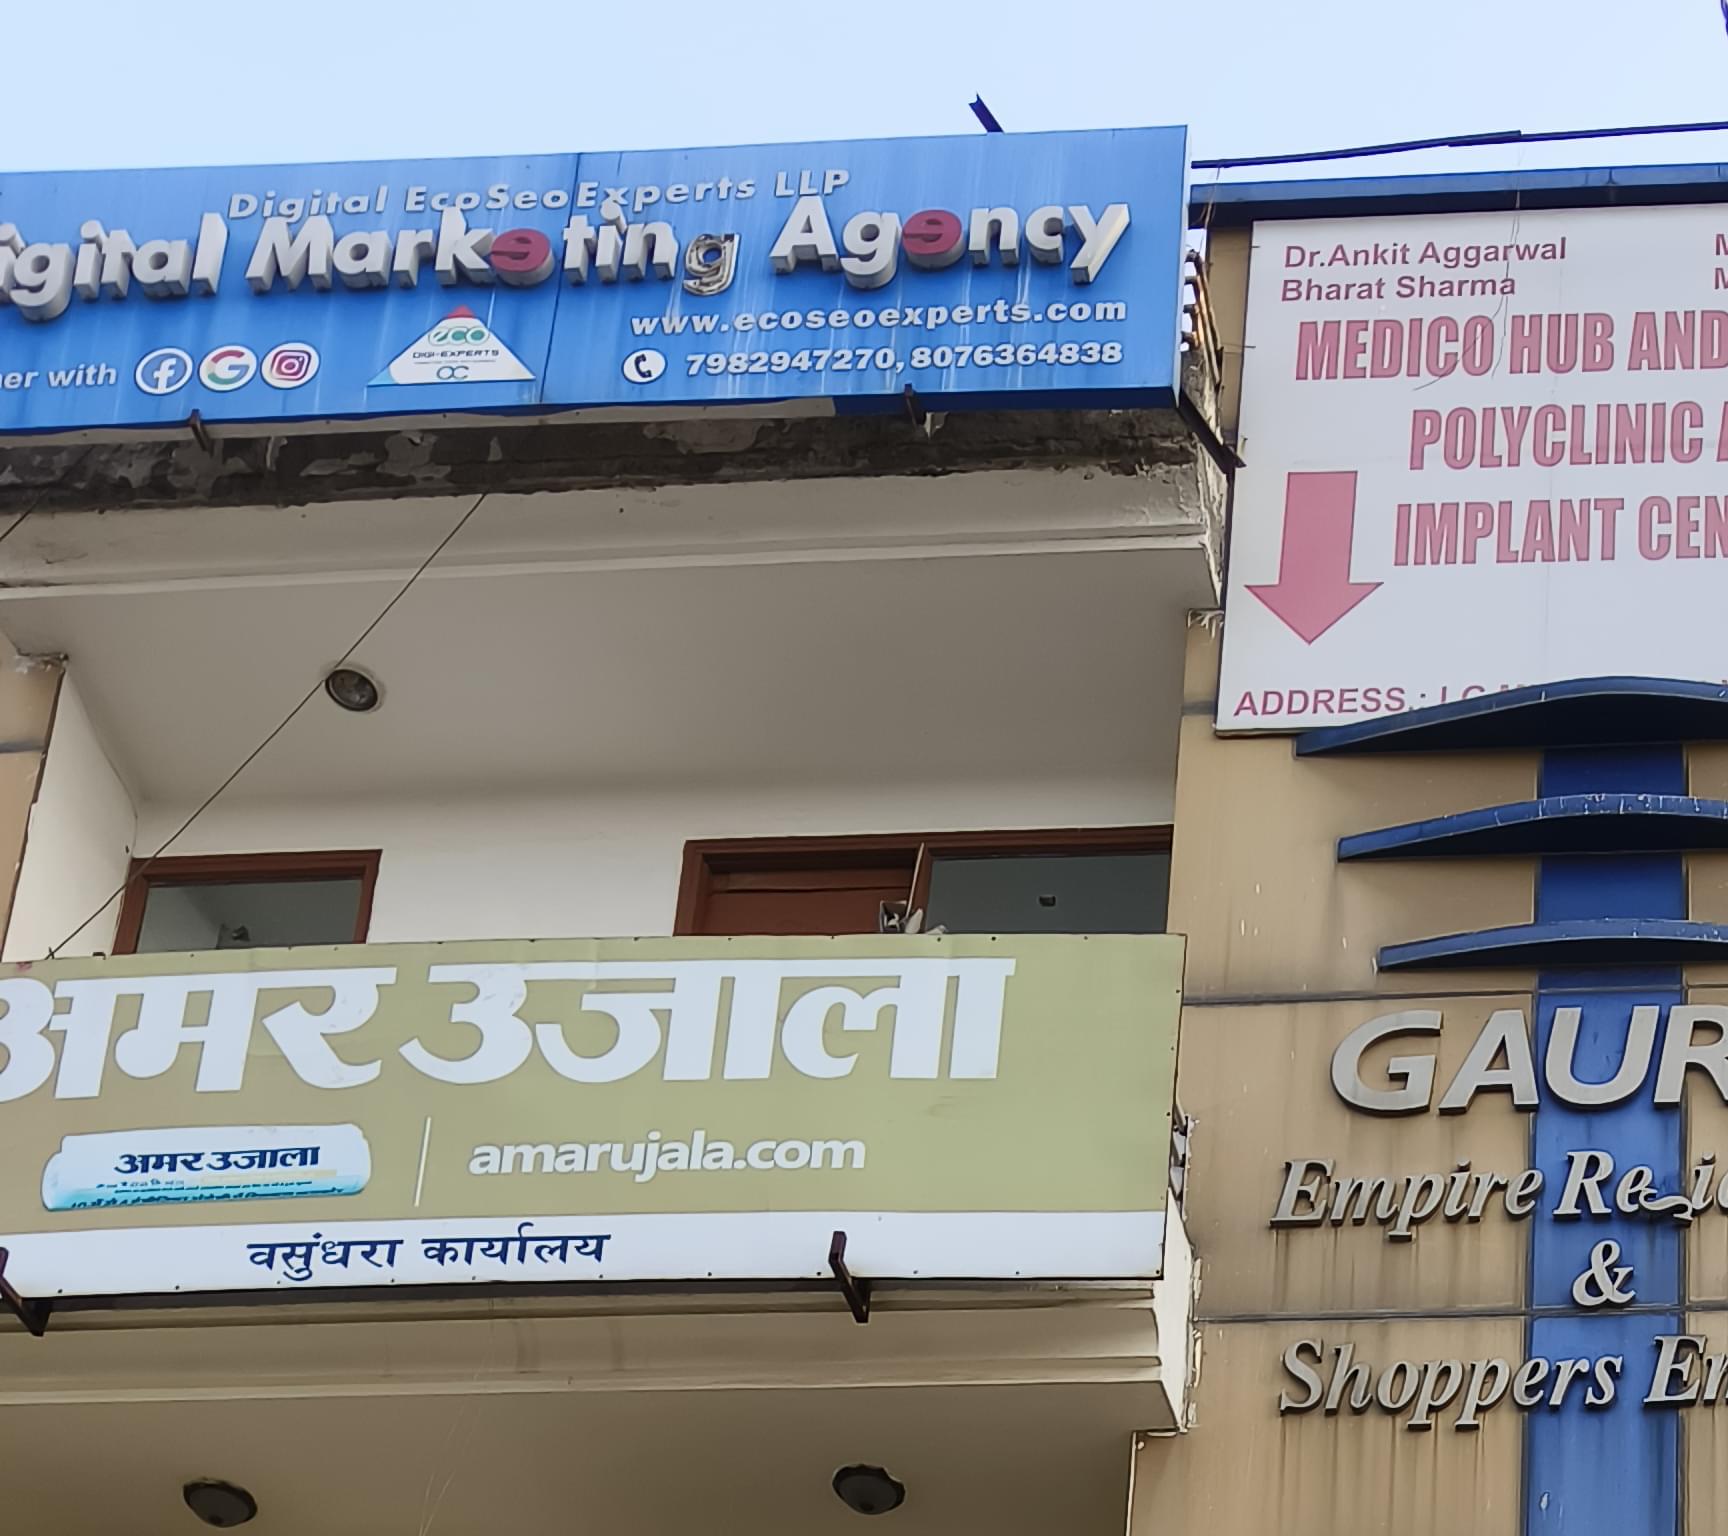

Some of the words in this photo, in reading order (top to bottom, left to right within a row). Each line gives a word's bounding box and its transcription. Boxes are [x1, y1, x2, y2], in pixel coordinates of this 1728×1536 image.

[229, 185, 388, 221] Digital
[775, 169, 850, 197] LLP
[245, 200, 742, 296] Marketing
[770, 195, 1130, 289] Agency
[1417, 237, 1566, 270] Aggarwal
[632, 299, 1127, 335] www.ecoseoexperts.com
[1281, 276, 1384, 303] Bharat
[1397, 273, 1516, 300] Sharma
[1295, 315, 1494, 382] MEDICO
[1510, 311, 1615, 375] HUB
[1409, 400, 1704, 470] POLYCLINIC
[1394, 496, 1625, 566] IMPLANT
[0, 967, 397, 1100] अमर
[398, 957, 1016, 1085] उजाला
[468, 1128, 866, 1184] amarujala.com
[1270, 1157, 1544, 1242] Empire
[247, 1232, 403, 1281] वसुंधरा
[421, 1223, 610, 1266] कार्यालय
[1571, 1239, 1637, 1309] &
[1279, 1338, 1624, 1432] Shoppers
